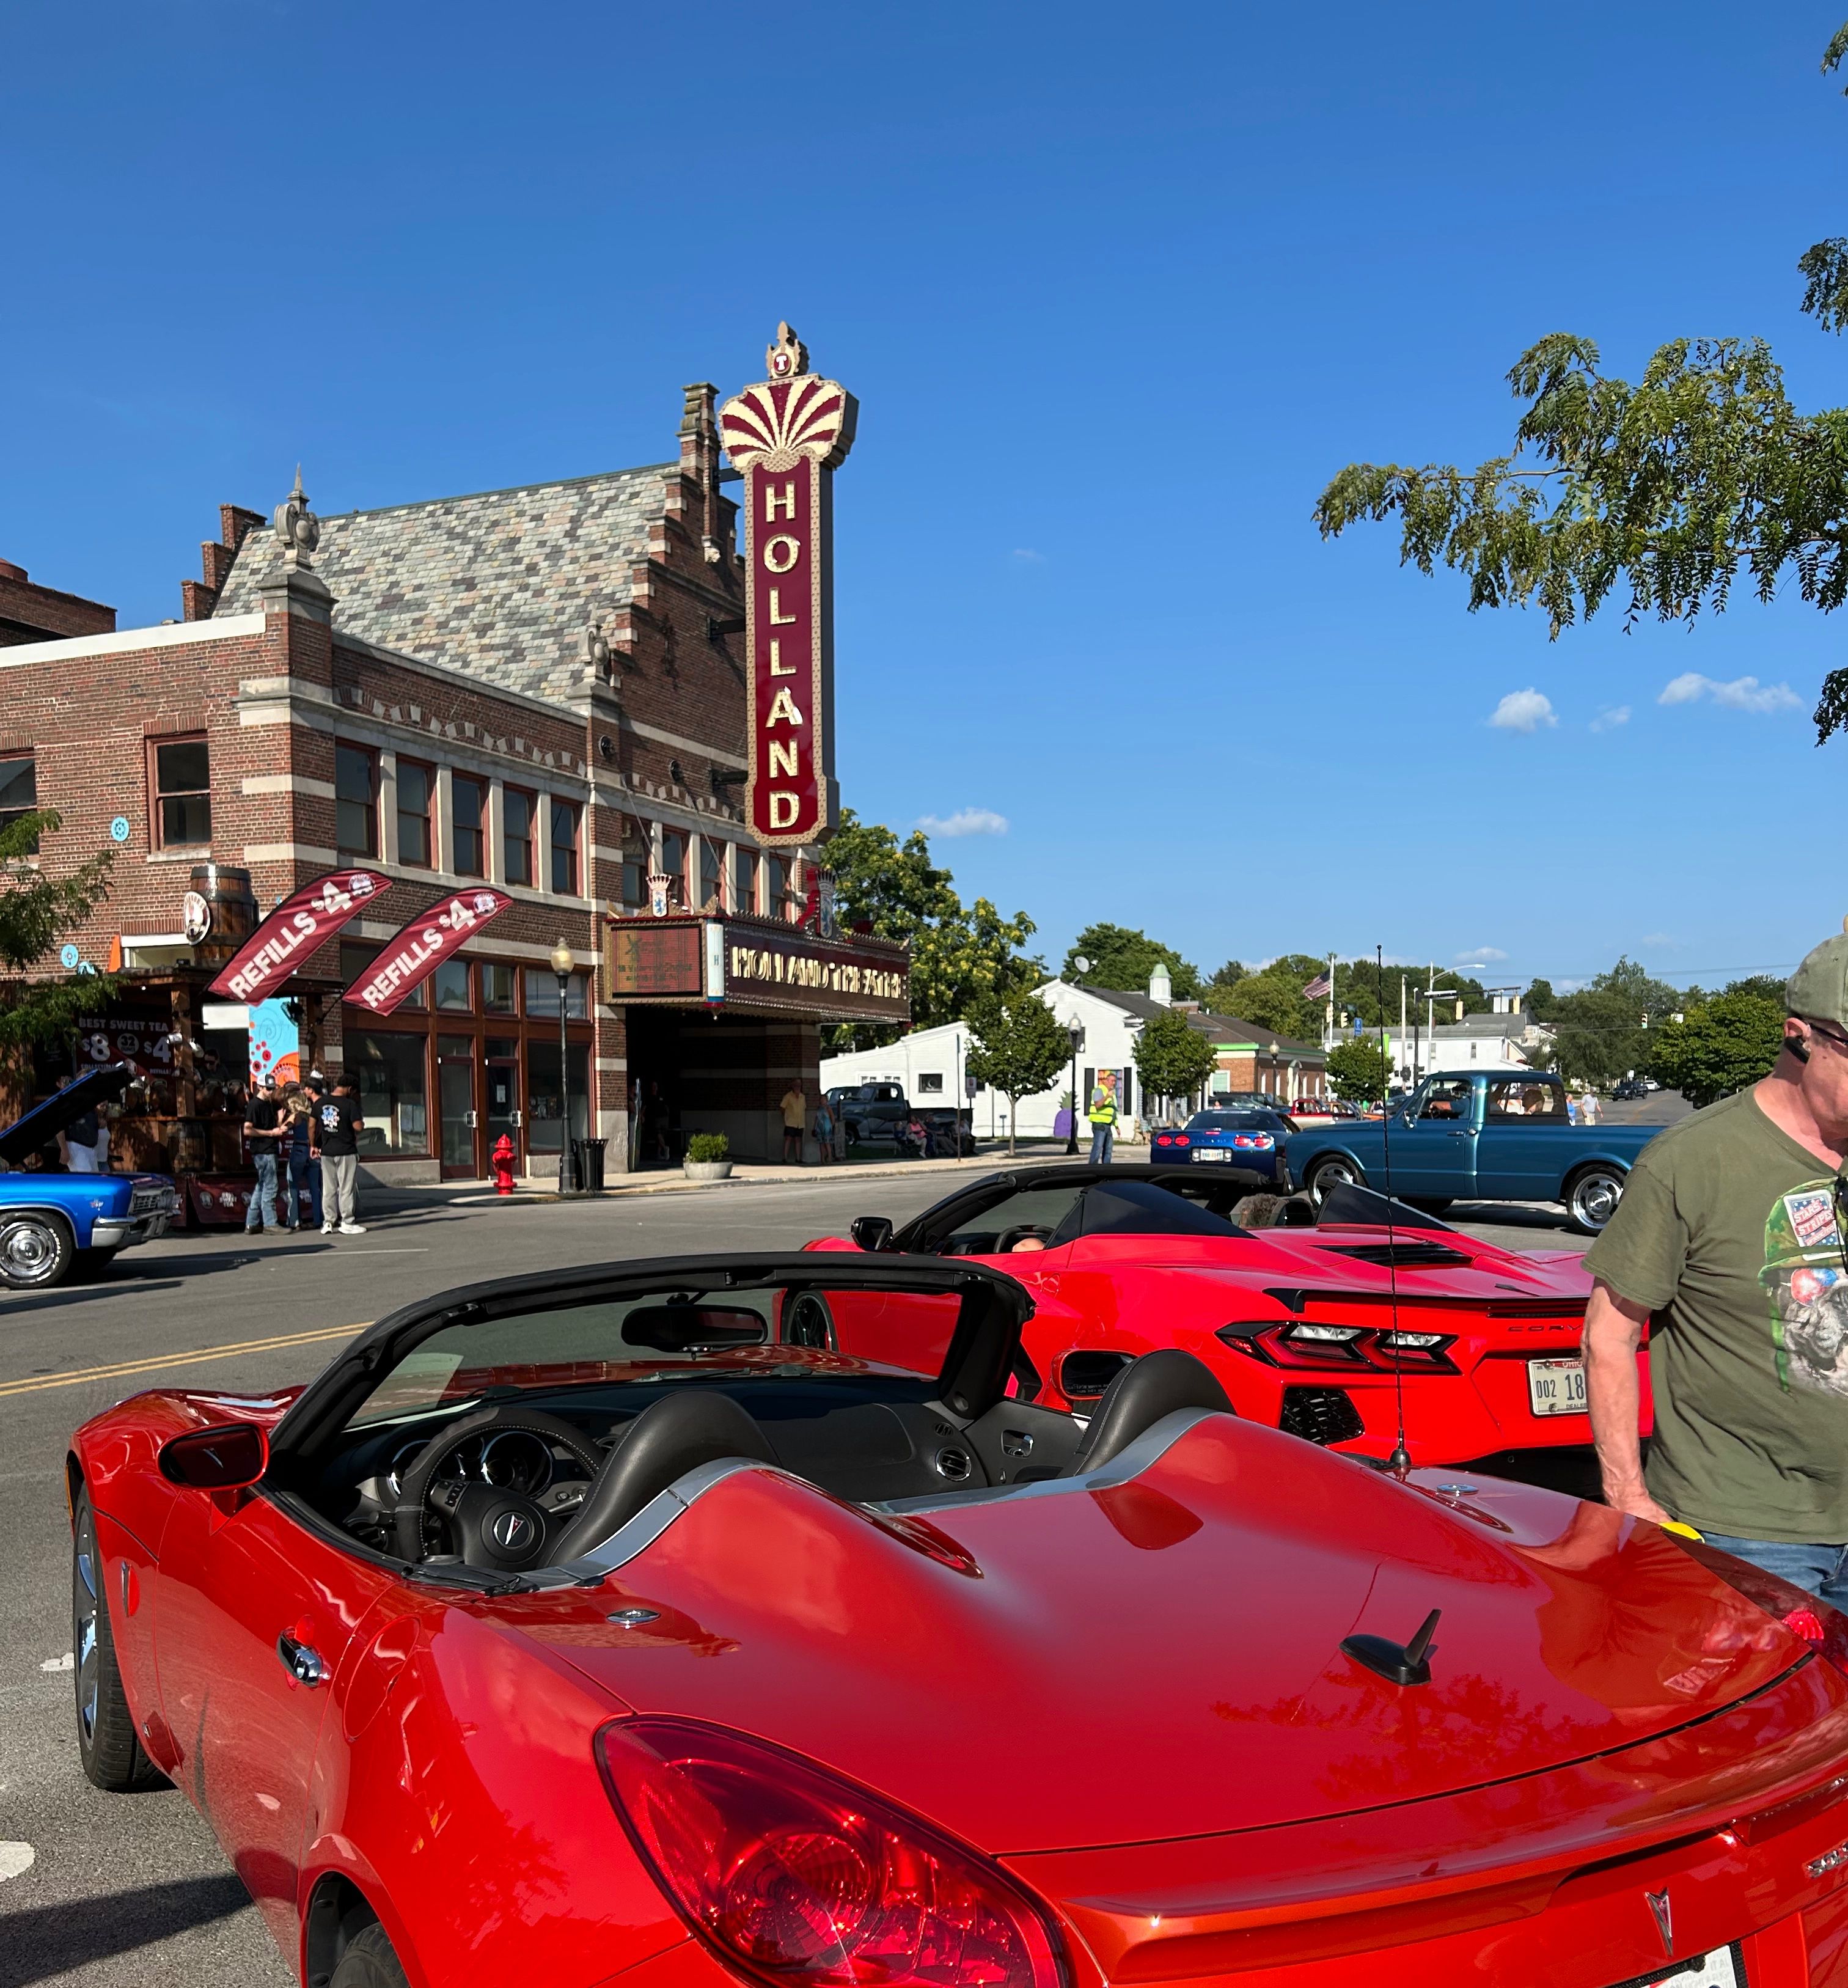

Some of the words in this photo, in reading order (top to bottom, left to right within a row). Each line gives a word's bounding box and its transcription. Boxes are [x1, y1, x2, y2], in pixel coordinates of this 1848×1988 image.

[764, 482, 803, 830] HOLLAND
[228, 912, 317, 1000] REFILLS
[311, 881, 353, 914] $4
[362, 928, 444, 1008] REFILLS
[439, 900, 477, 931] $4
[79, 1018, 106, 1029] BEST
[110, 1020, 145, 1031] SWEET
[149, 1022, 169, 1032] TEA
[81, 1033, 111, 1061] $8
[121, 1036, 135, 1046] 32
[144, 1036, 171, 1063] $4
